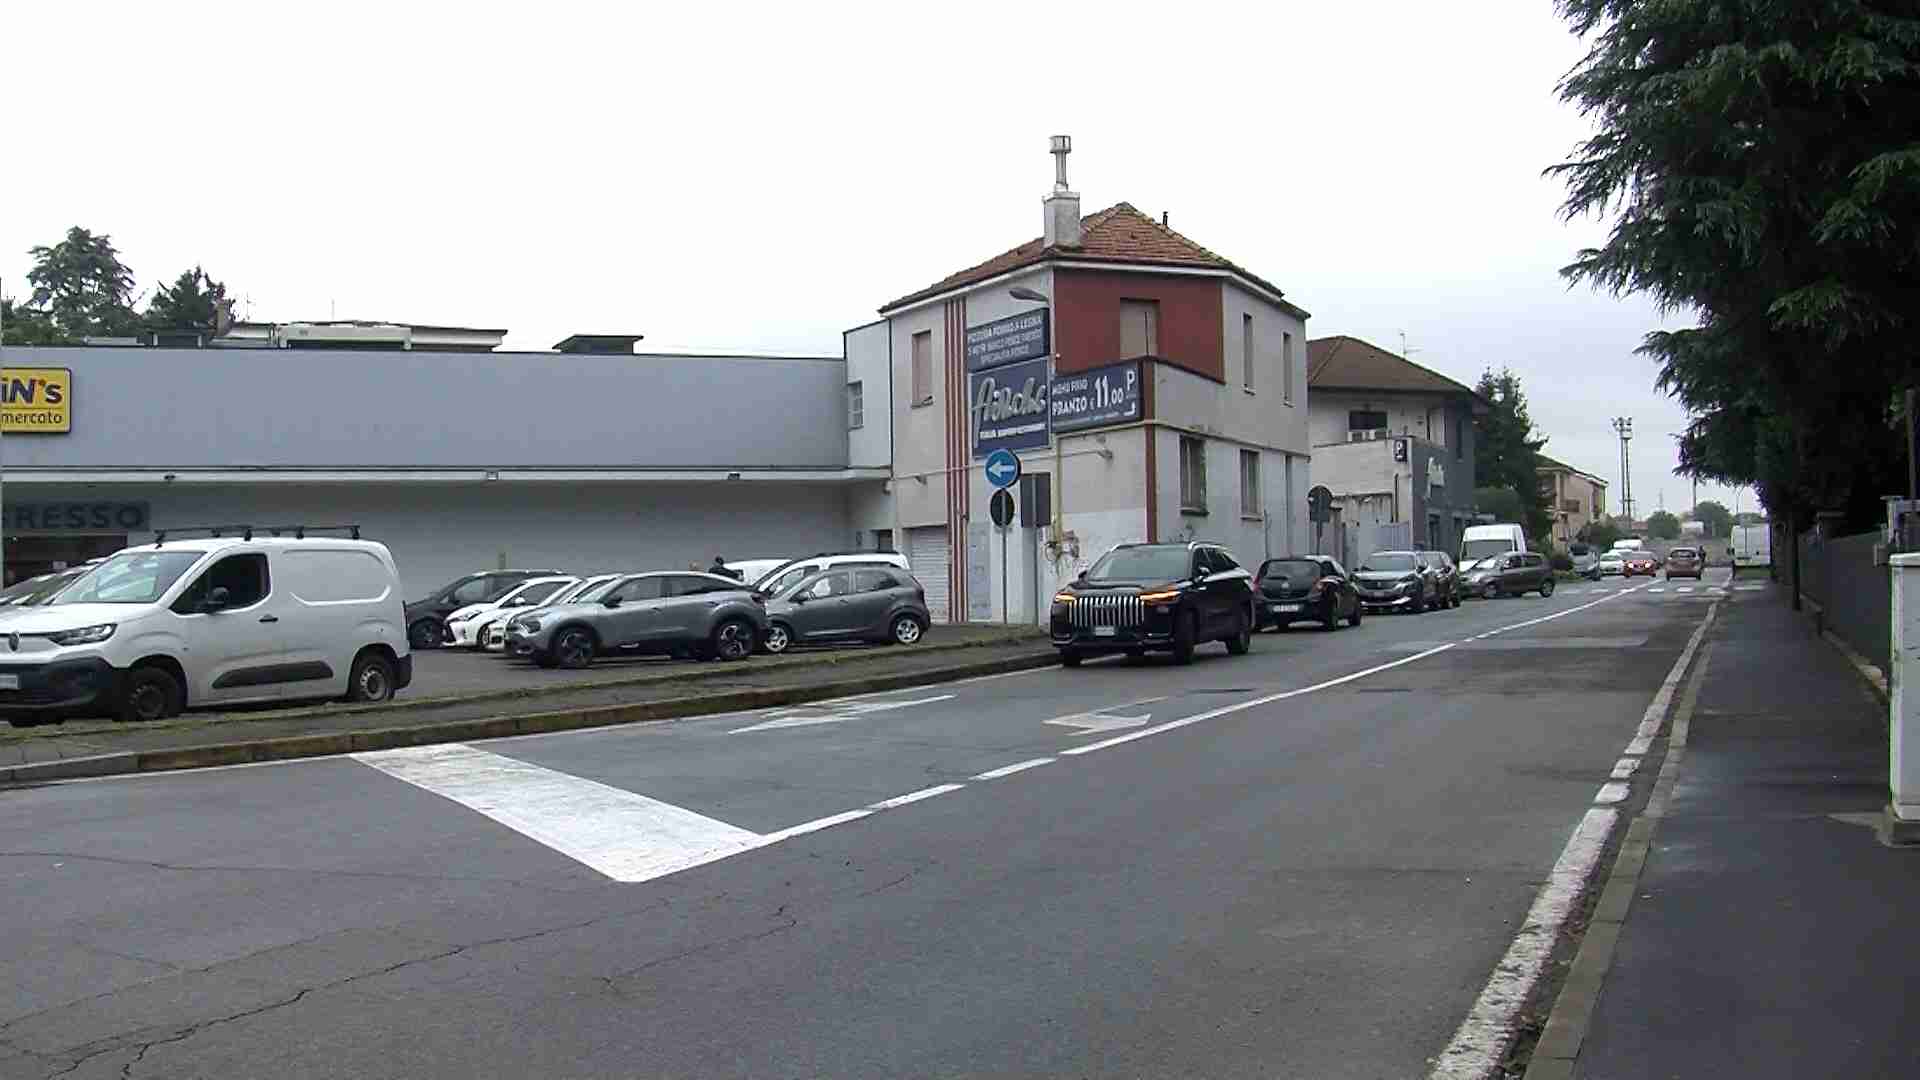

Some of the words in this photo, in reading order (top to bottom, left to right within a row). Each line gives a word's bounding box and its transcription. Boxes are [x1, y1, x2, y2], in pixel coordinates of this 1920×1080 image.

[1052, 396, 1088, 416] PRANZO
[1, 410, 63, 424] mercato
[2, 504, 145, 529] RESSO
